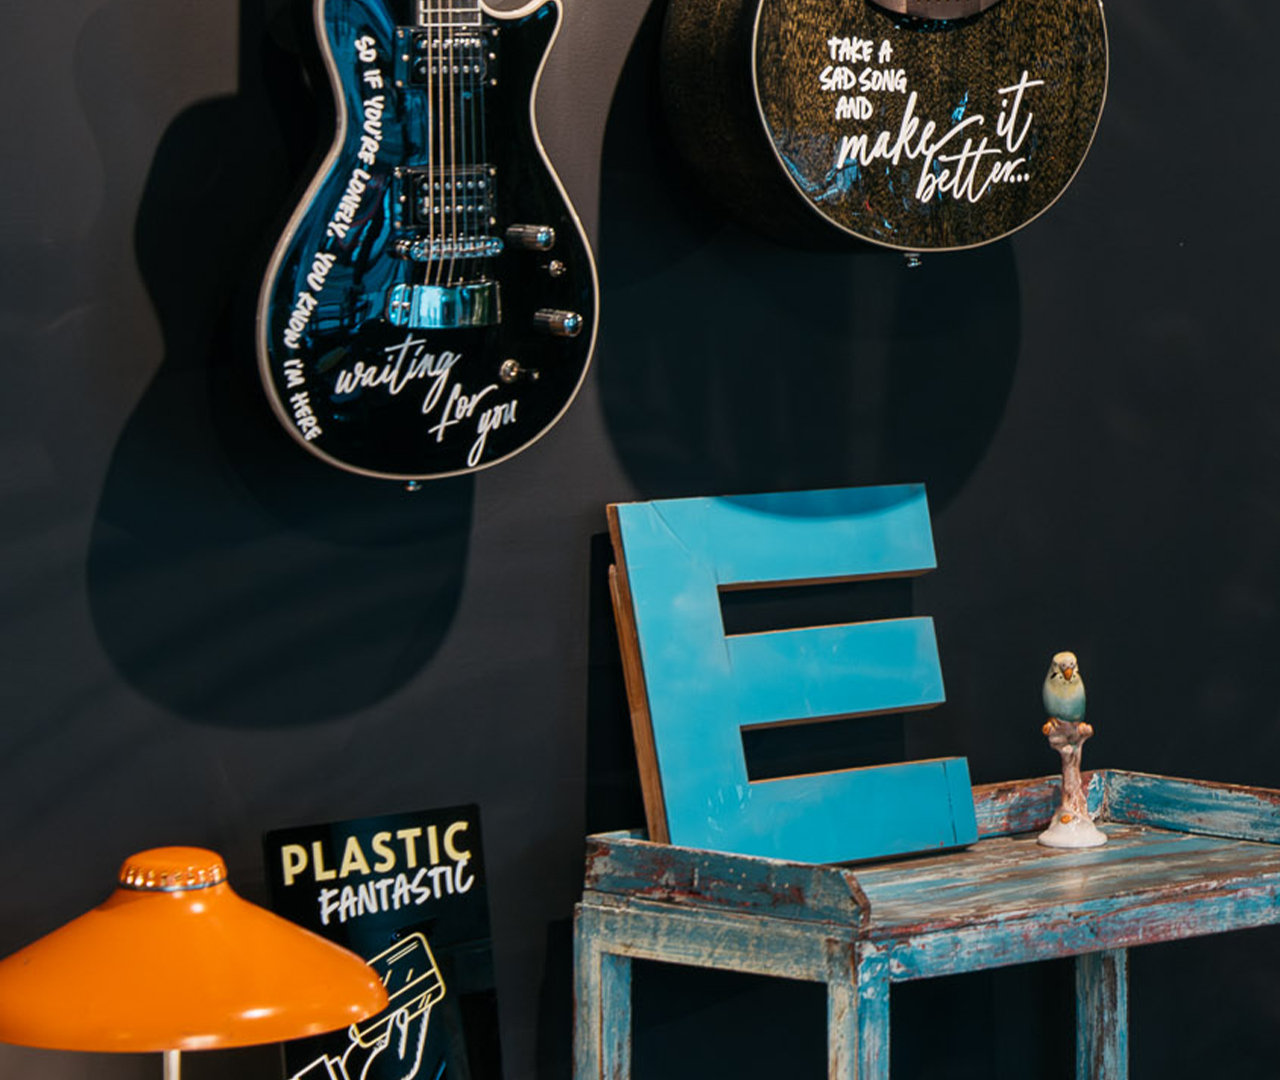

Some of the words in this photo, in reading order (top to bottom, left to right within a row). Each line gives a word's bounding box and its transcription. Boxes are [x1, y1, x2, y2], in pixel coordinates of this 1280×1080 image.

[354, 35, 376, 63] SO
[827, 36, 874, 64] TAKE
[878, 39, 893, 63] A
[363, 69, 383, 90] IF
[819, 66, 856, 92] SAD
[857, 67, 908, 94] SONG
[835, 95, 873, 120] AND
[358, 94, 384, 166] YOU'RE
[836, 91, 984, 170] make
[997, 70, 1045, 153] it
[306, 251, 336, 292] YOU
[284, 290, 318, 349] KNOW
[283, 358, 305, 389] I'M
[335, 332, 463, 415] waiting
[289, 391, 323, 442] HERE
[427, 382, 499, 443] for
[466, 399, 519, 468] you
[607, 483, 978, 864] E
[281, 821, 473, 887] PLASTIC
[317, 858, 475, 926] FANTASTIC
